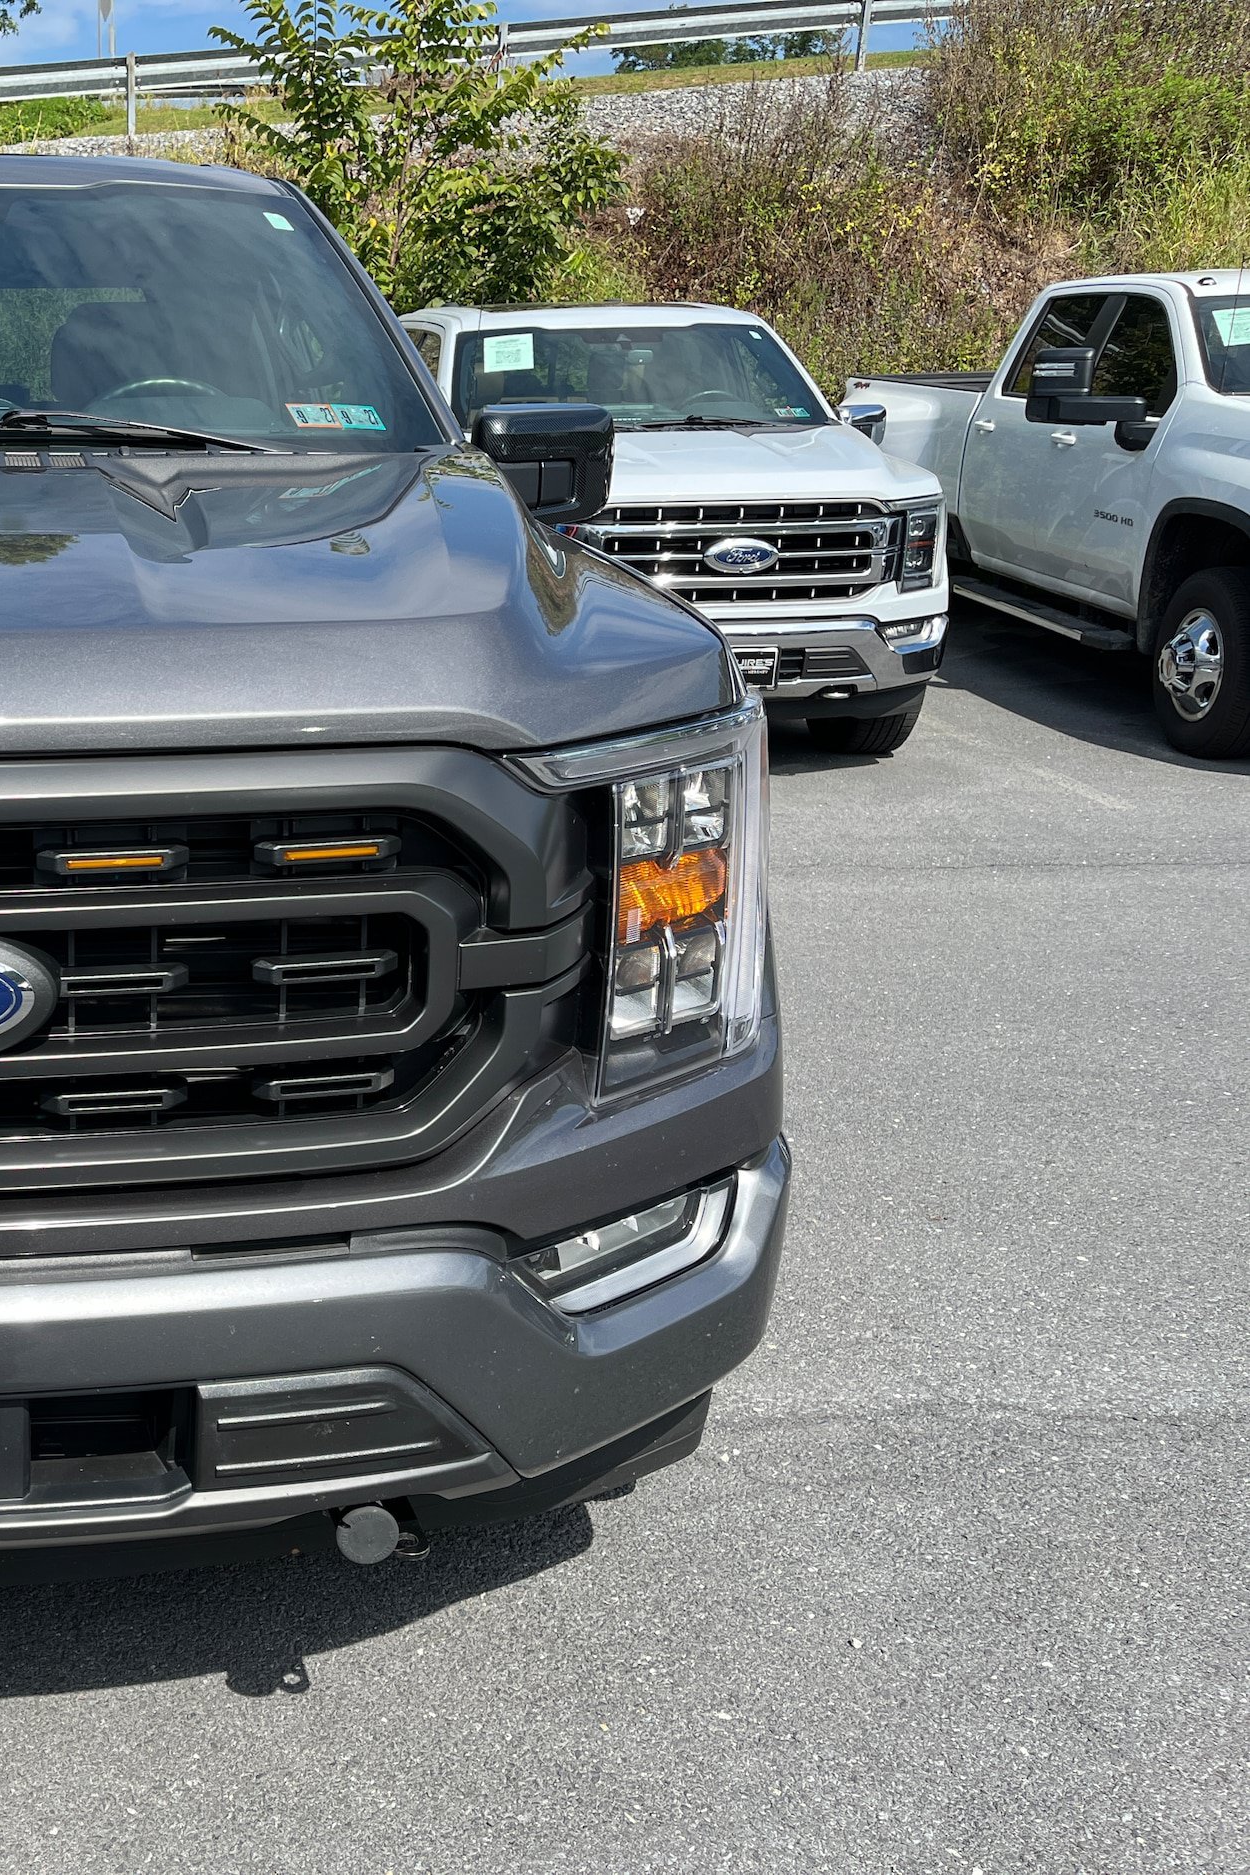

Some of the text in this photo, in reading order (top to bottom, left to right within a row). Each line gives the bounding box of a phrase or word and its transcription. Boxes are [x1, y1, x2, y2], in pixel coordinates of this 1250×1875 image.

[1093, 509, 1134, 527] 3500 HD
[726, 547, 762, 563] Ford
